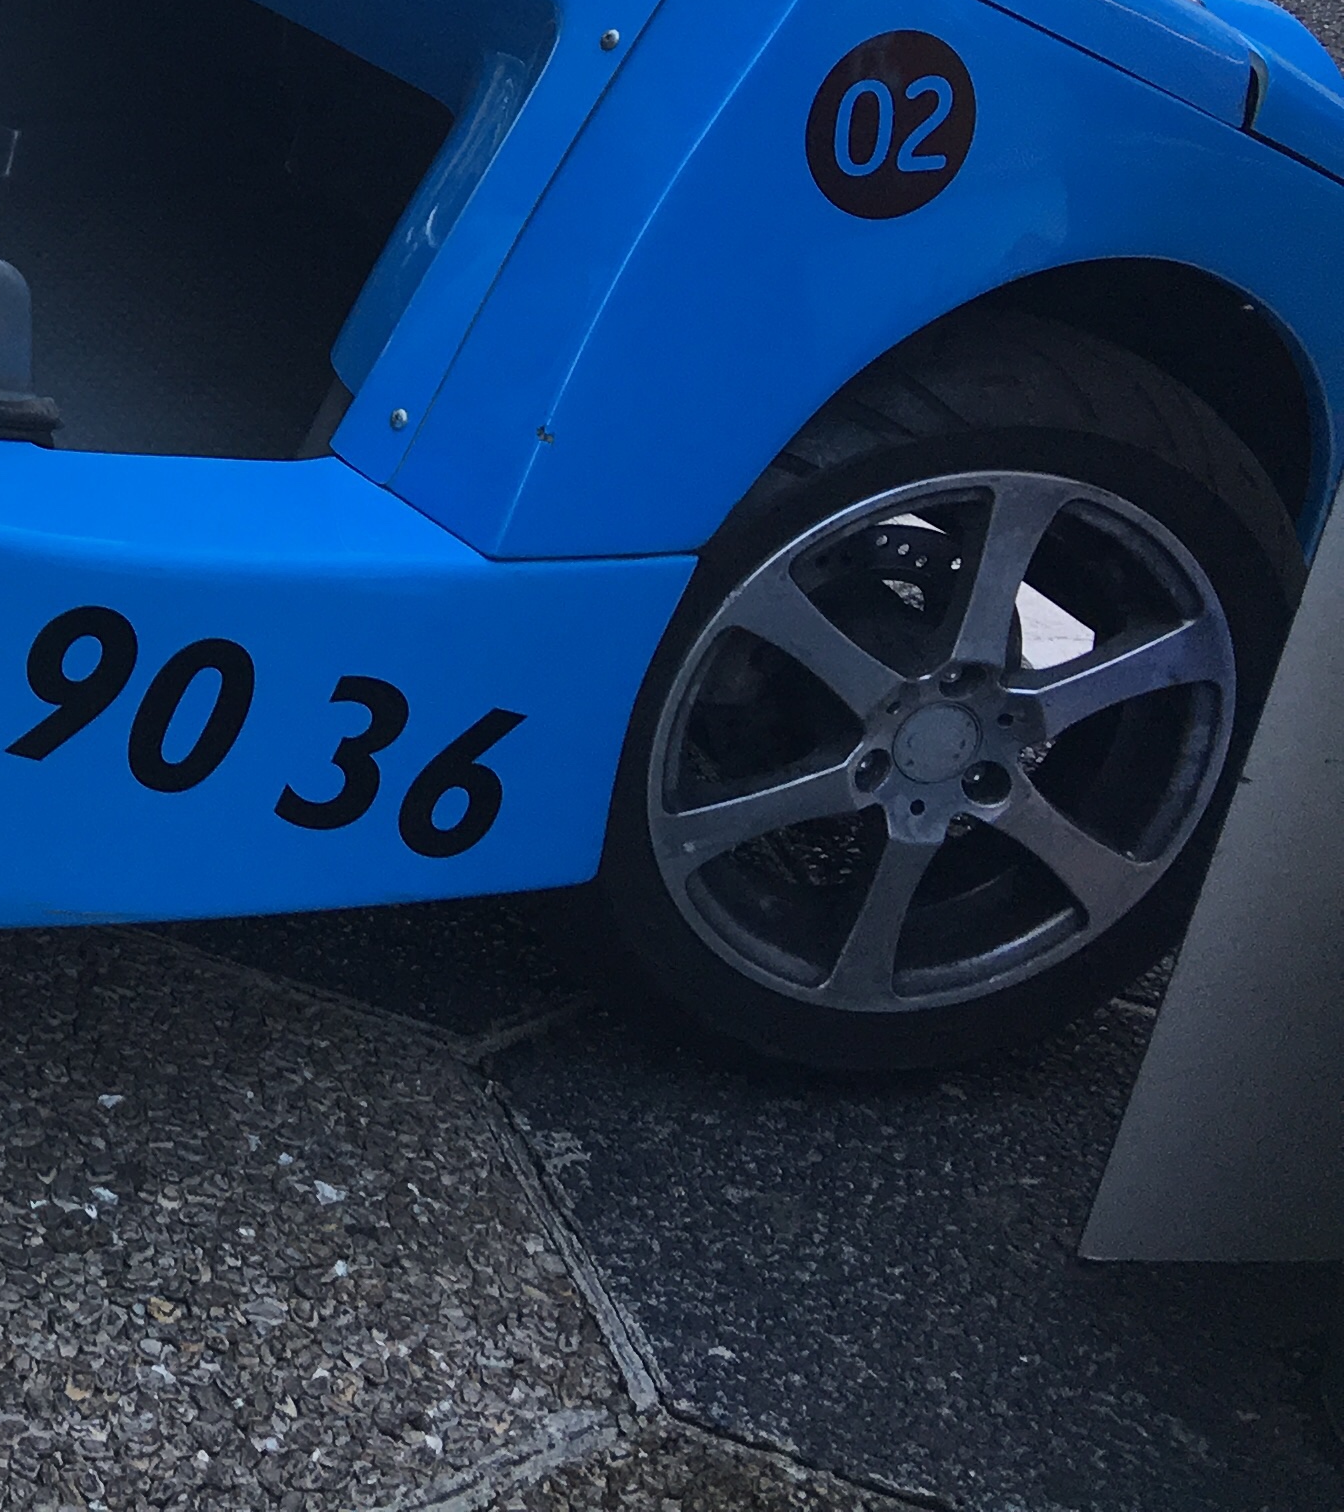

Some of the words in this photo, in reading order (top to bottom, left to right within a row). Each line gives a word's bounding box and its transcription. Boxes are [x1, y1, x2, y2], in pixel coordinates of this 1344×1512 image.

[833, 73, 954, 177] 02
[4, 604, 257, 794] 90
[272, 675, 529, 860] 36
